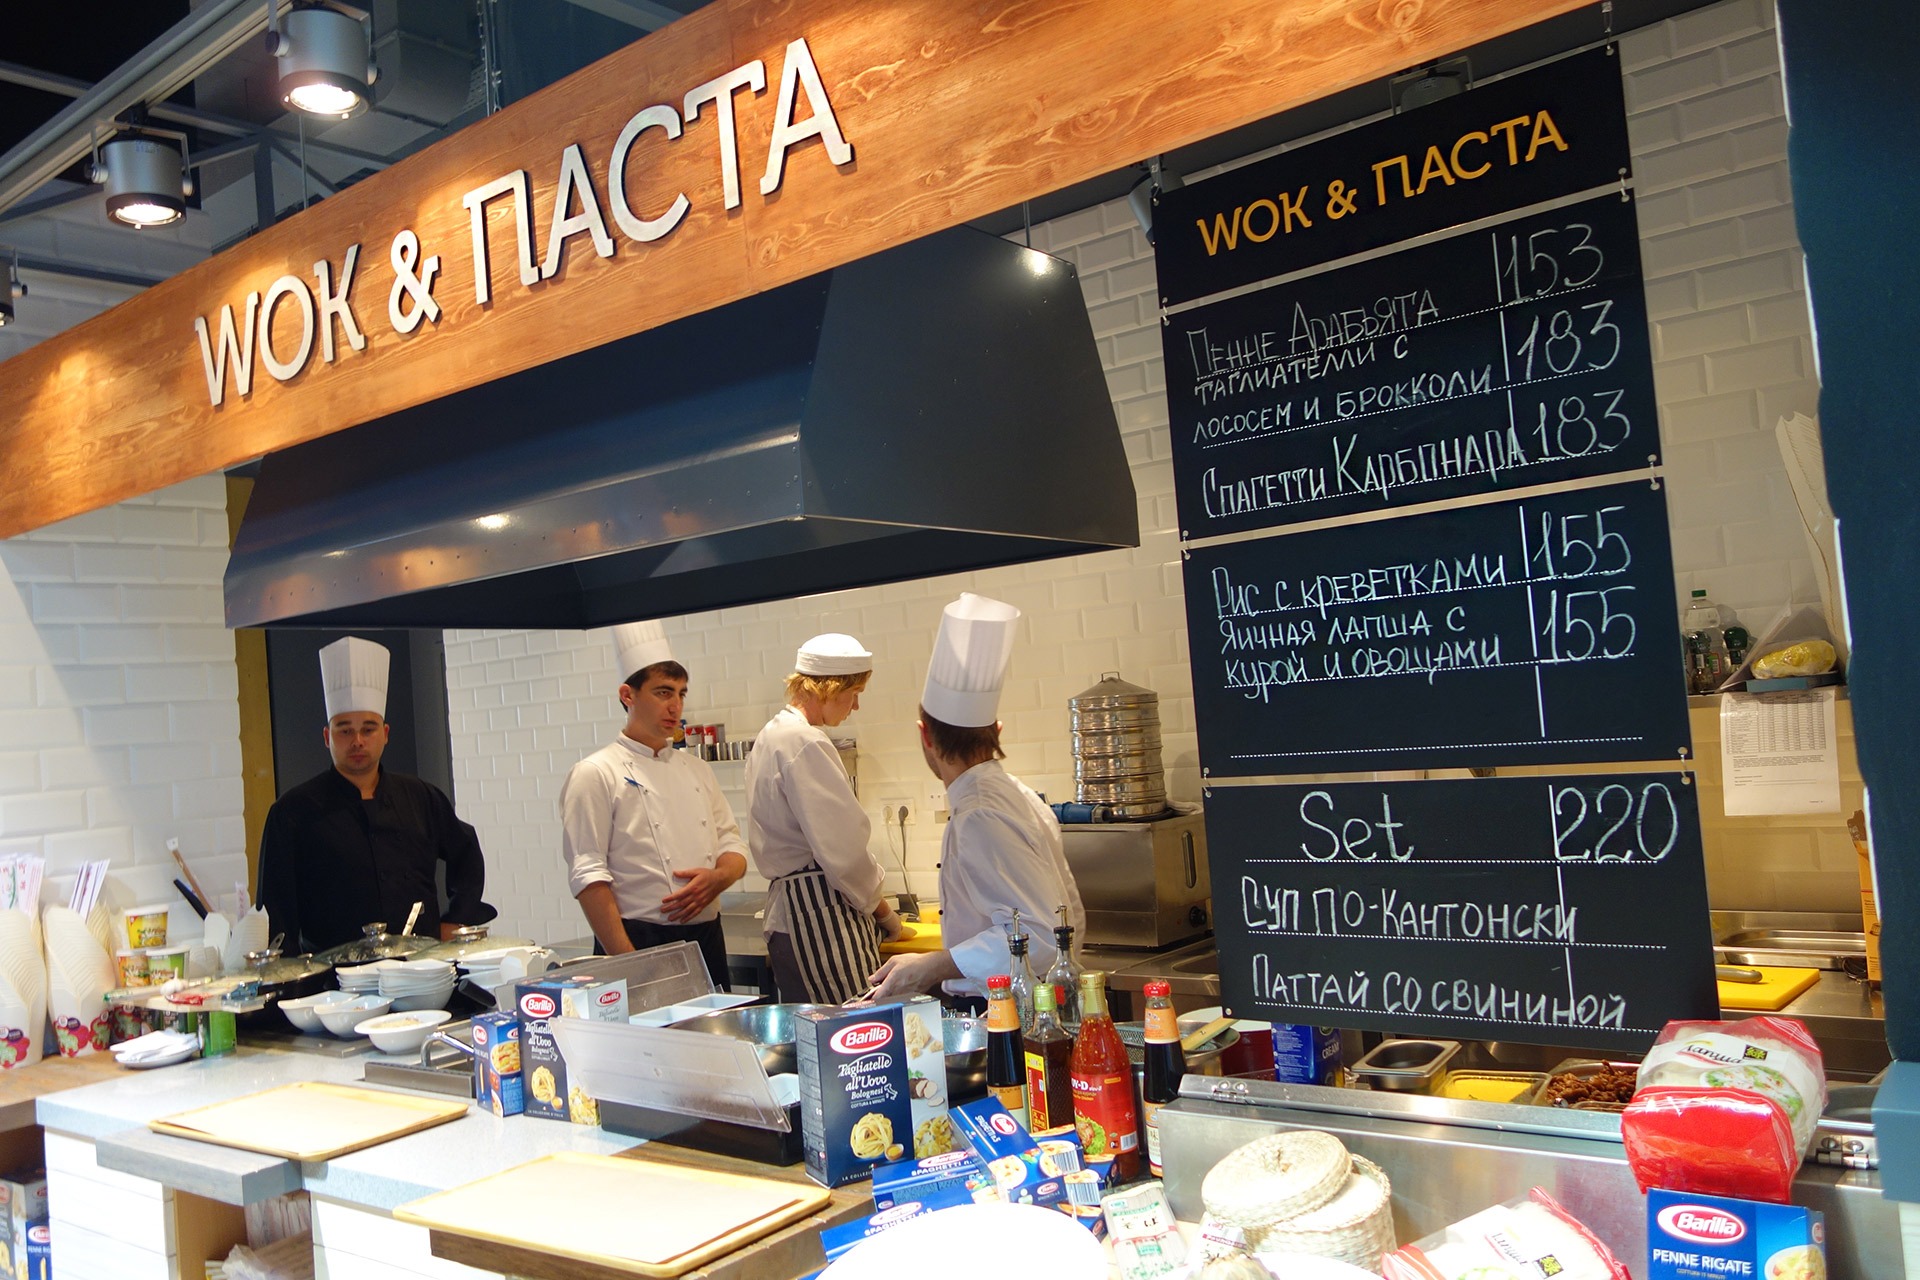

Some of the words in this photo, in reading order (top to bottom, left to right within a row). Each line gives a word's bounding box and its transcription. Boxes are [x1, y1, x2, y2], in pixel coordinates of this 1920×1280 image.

[1196, 186, 1312, 256] WOK
[1326, 180, 1357, 220] &
[1371, 110, 1568, 205] ПАСТА
[195, 244, 365, 407] WOK
[389, 229, 441, 334] &
[463, 37, 852, 304] ПАСТА
[1504, 223, 1604, 305] 153
[1516, 300, 1621, 382] 183
[1532, 388, 1631, 461] 183
[1532, 505, 1632, 582] 155
[1541, 585, 1637, 666] 155
[1300, 791, 1415, 862] Set
[1555, 781, 1679, 863] 220
[528, 999, 552, 1012] Barilla
[845, 1027, 888, 1047] Barilla
[838, 1054, 891, 1079] Tagliatelle
[845, 1074, 887, 1092] all'Uovo
[851, 1086, 884, 1100] Bolognesi
[911, 1161, 961, 1177] SPAGHETTI
[1676, 1213, 1738, 1237] Barilla
[1652, 1248, 1700, 1268] PENNE
[1700, 1255, 1753, 1277] RIGATE
